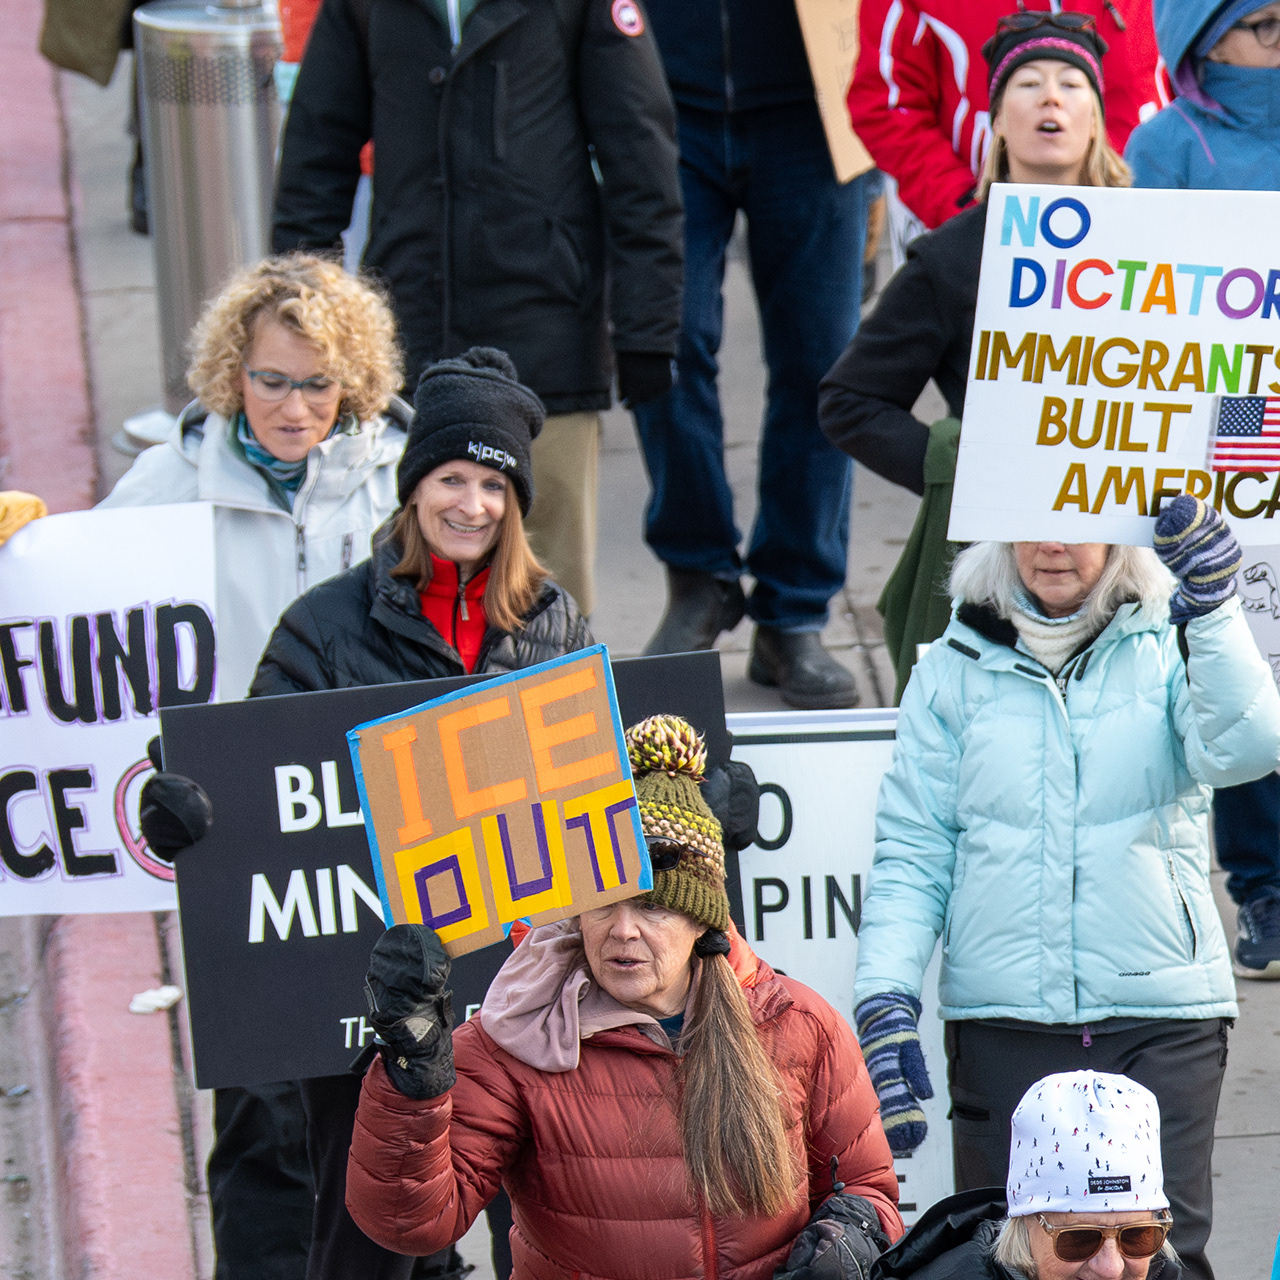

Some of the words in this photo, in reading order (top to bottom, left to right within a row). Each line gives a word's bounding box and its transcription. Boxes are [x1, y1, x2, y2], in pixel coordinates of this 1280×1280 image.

[1000, 194, 1092, 249] NO
[1036, 395, 1193, 453] BUILT
[0, 600, 216, 724] FUND
[380, 666, 617, 845] ICE
[392, 778, 637, 943] OUT
